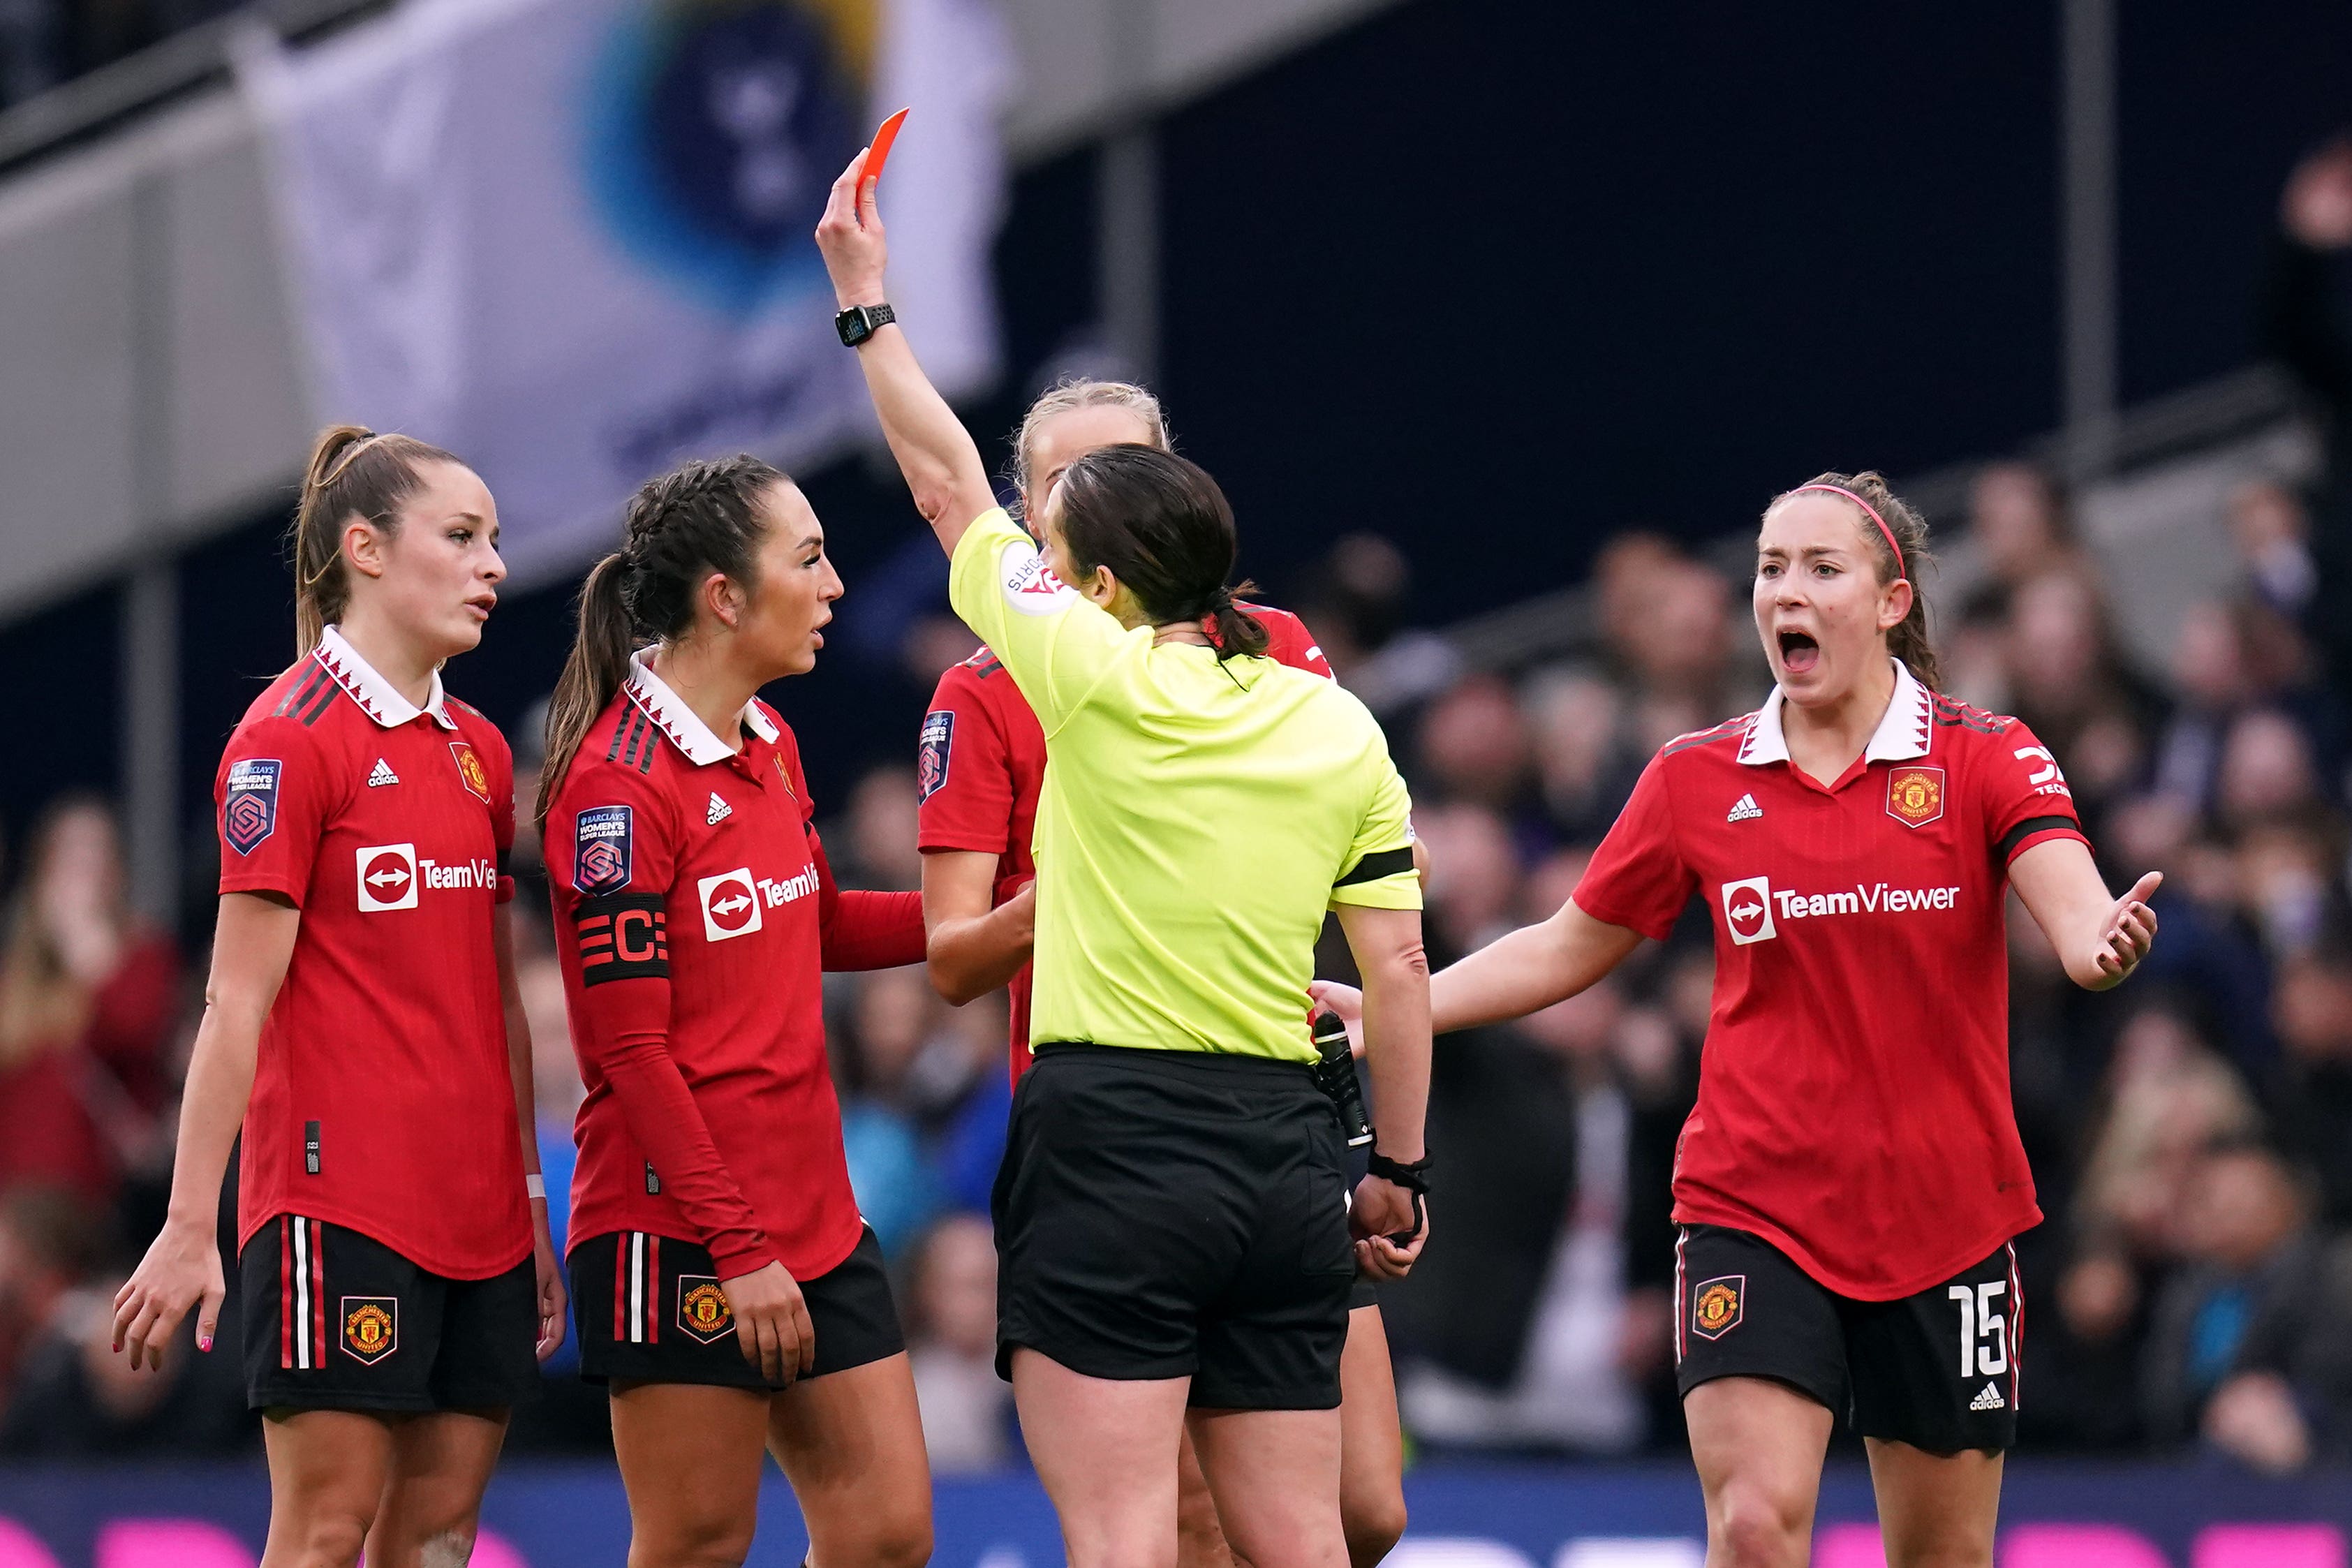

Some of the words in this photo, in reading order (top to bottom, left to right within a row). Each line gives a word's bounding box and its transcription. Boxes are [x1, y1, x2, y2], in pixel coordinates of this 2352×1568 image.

[1008, 557, 1045, 591] ORTS
[232, 774, 274, 785] WOMEN'S
[368, 774, 399, 787] adidas
[587, 813, 626, 824] BARCLAYS
[707, 805, 733, 825] adidas
[1727, 808, 1763, 822] adidas
[580, 821, 626, 835] WOMEN'S
[580, 831, 598, 841] SUPER
[1773, 883, 1960, 919] TeamViewer
[615, 908, 655, 962] C
[697, 1320, 721, 1330] UNITED
[1948, 1280, 2008, 1378] 15
[357, 1341, 384, 1351] UNITED
[1969, 1398, 2005, 1411] adidas
